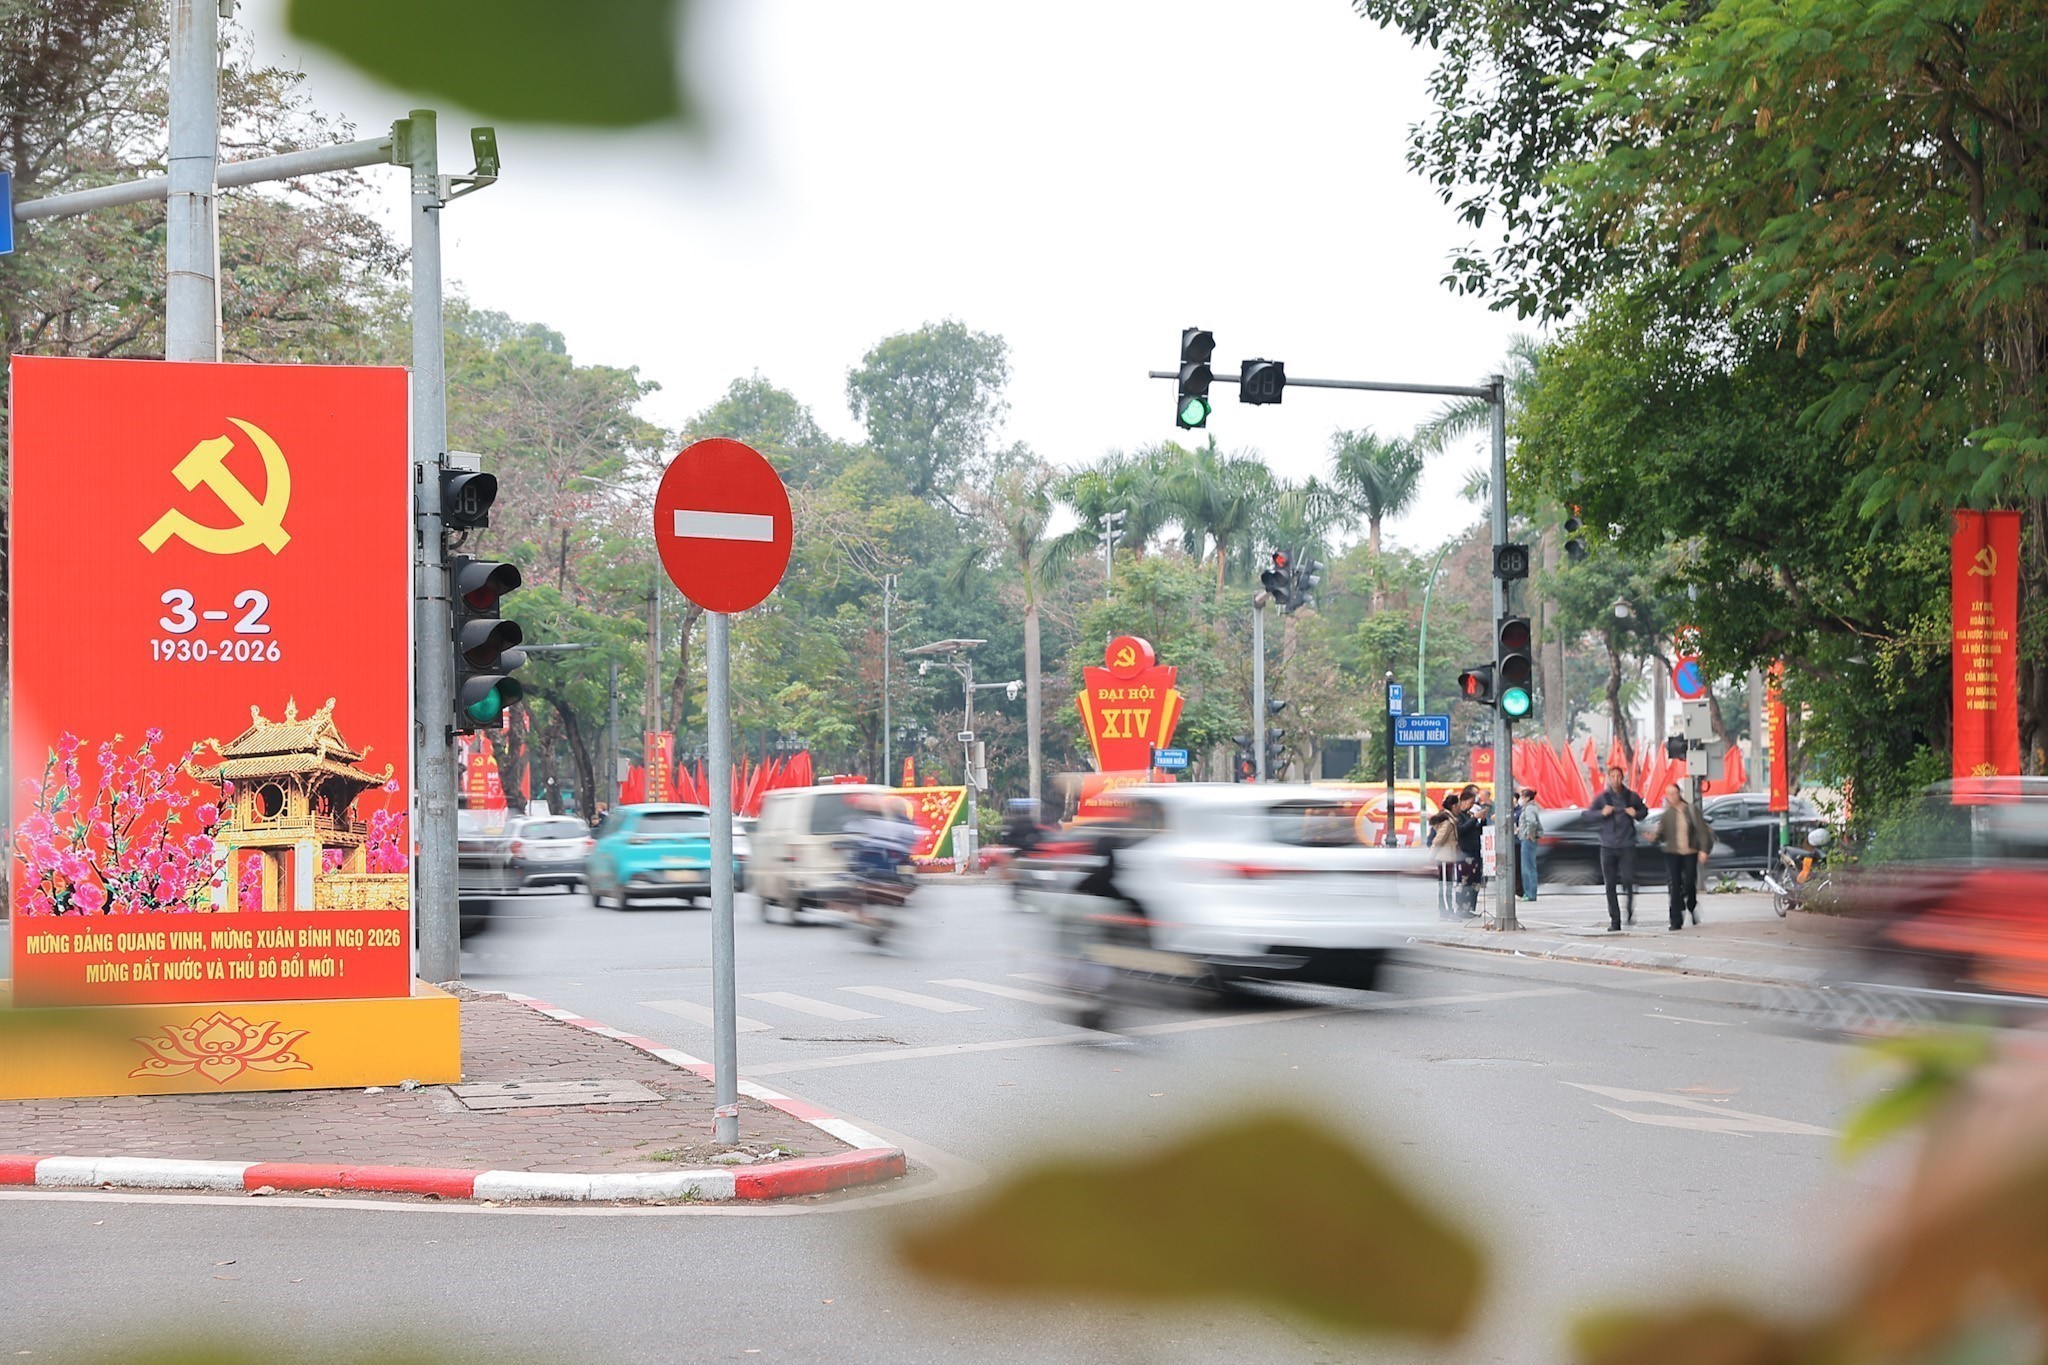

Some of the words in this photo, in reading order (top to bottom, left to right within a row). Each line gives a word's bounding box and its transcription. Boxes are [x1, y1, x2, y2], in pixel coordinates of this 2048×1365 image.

[159, 588, 271, 634] 3-2
[150, 639, 281, 662] 1930-2026
[1098, 688, 1124, 702] ĐẠI
[1128, 684, 1155, 702] HỘI
[1101, 708, 1151, 738] XIV
[1398, 730, 1425, 741] THANH
[1426, 728, 1445, 741] NIÊN
[1411, 718, 1441, 727] ĐƯỜNG
[26, 931, 70, 955] MỪNG
[73, 926, 113, 953] ĐẢNG
[117, 931, 166, 954] QUANG
[170, 931, 207, 952] VINH,
[210, 926, 253, 950] MỪNG
[256, 926, 295, 949] XUÂN
[298, 925, 332, 948] BÍNH
[335, 929, 364, 951] NGỌ
[367, 928, 401, 947] 2026
[86, 959, 129, 984] MỪNG
[132, 955, 160, 981] ĐẤT
[163, 956, 203, 980] NƯỚC
[206, 957, 225, 980] VÀ
[228, 953, 255, 979] THỦ
[258, 956, 278, 979] ĐÔ
[280, 952, 304, 978] ĐỔI
[308, 954, 335, 977] MỚI
